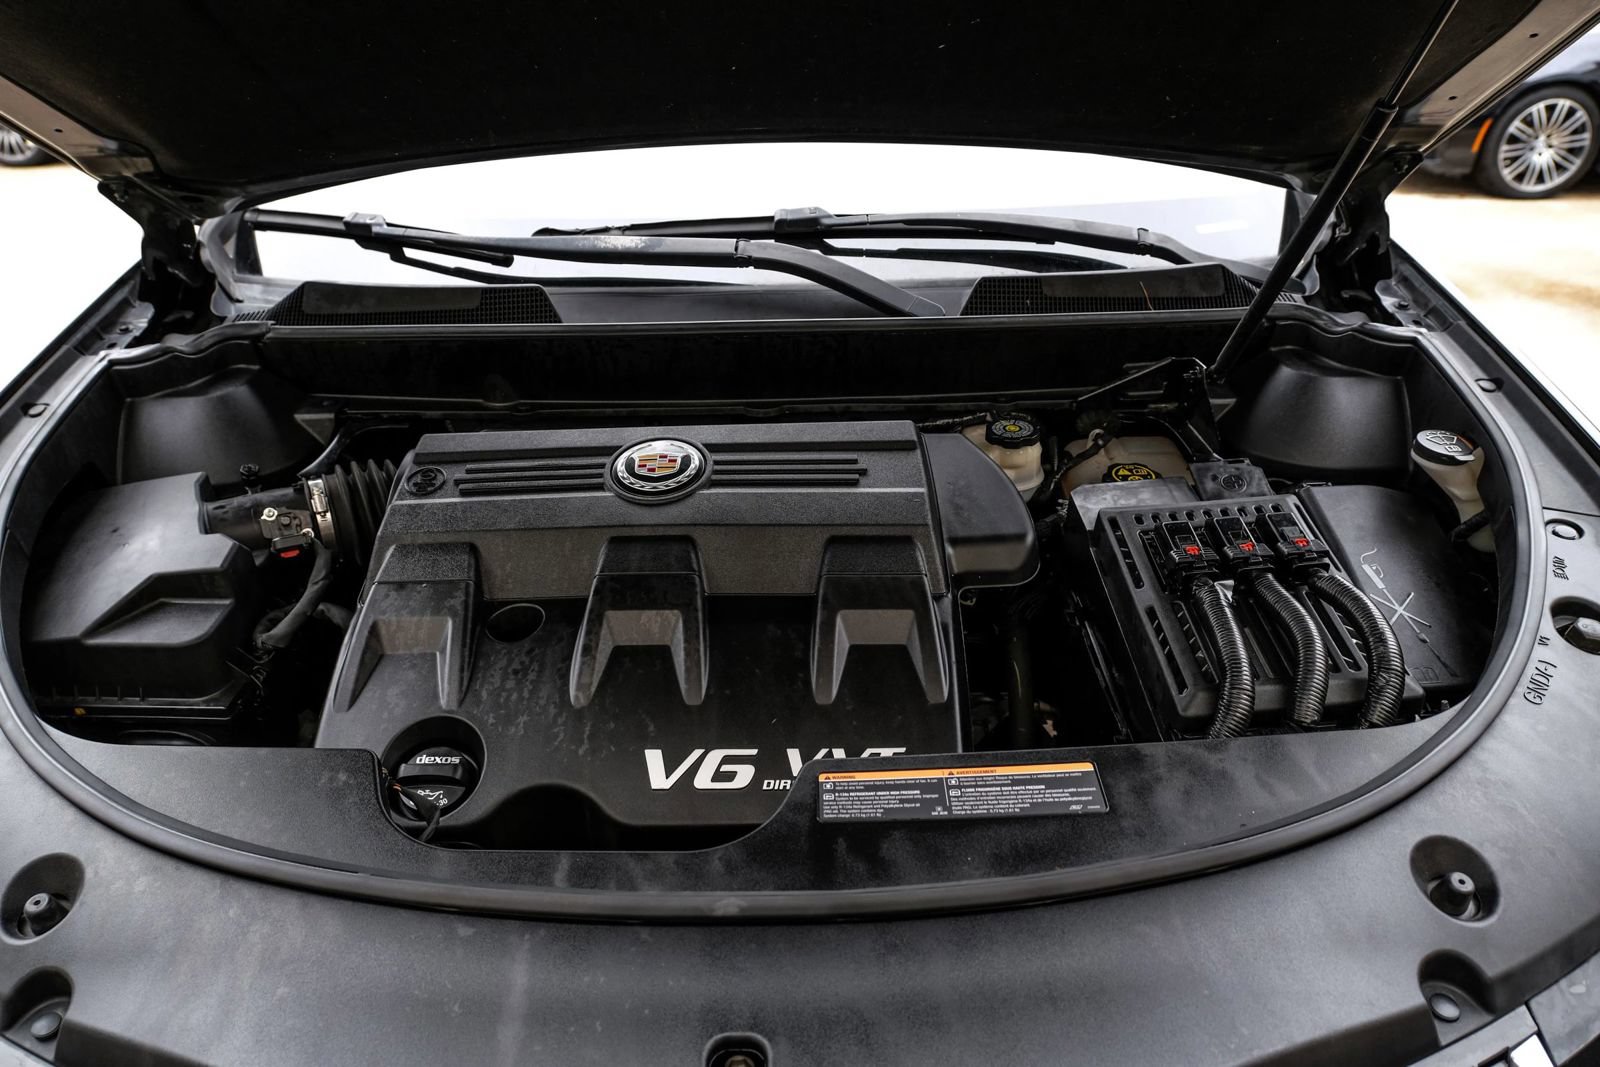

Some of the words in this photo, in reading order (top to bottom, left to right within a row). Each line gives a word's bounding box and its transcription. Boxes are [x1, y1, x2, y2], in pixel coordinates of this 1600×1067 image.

[416, 754, 462, 764] dexos
[644, 748, 758, 790] V6
[786, 748, 906, 776] VT
